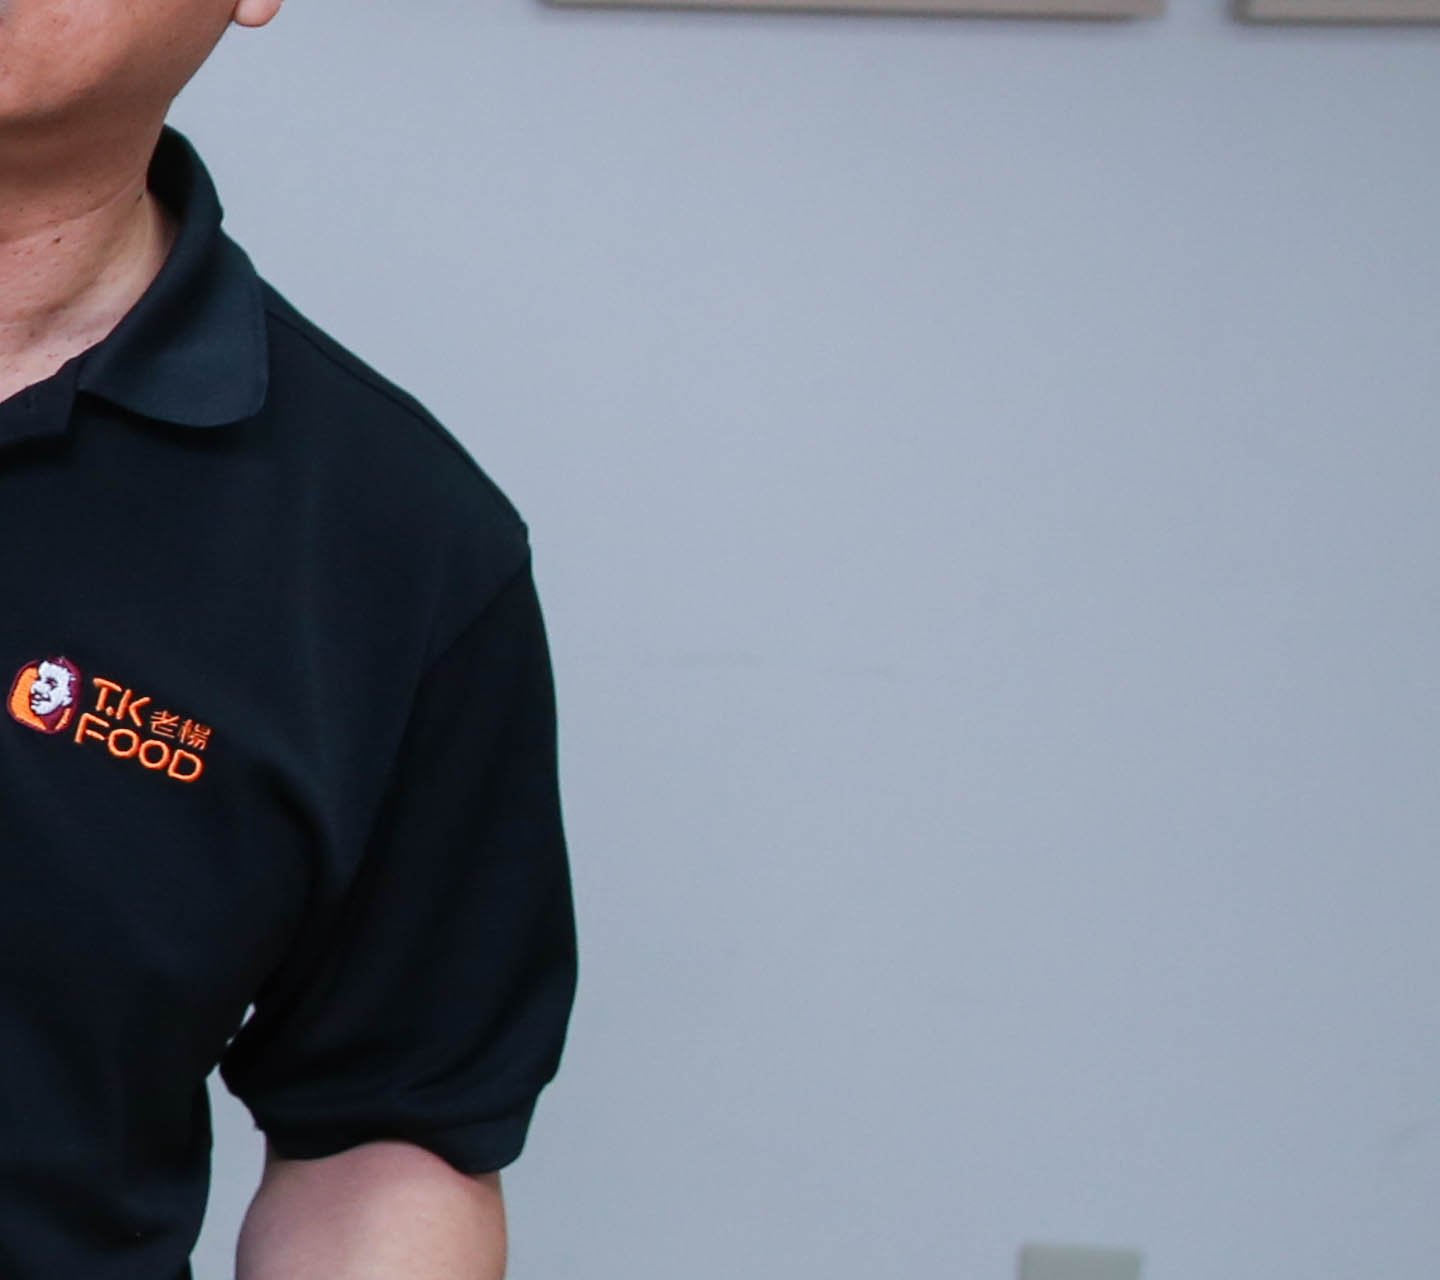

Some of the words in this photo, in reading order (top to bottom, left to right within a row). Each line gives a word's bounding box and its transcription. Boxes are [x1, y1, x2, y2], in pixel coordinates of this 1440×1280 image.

[73, 712, 205, 783] FOOD
[93, 677, 153, 728] T.K
[149, 710, 213, 751] 老楊
